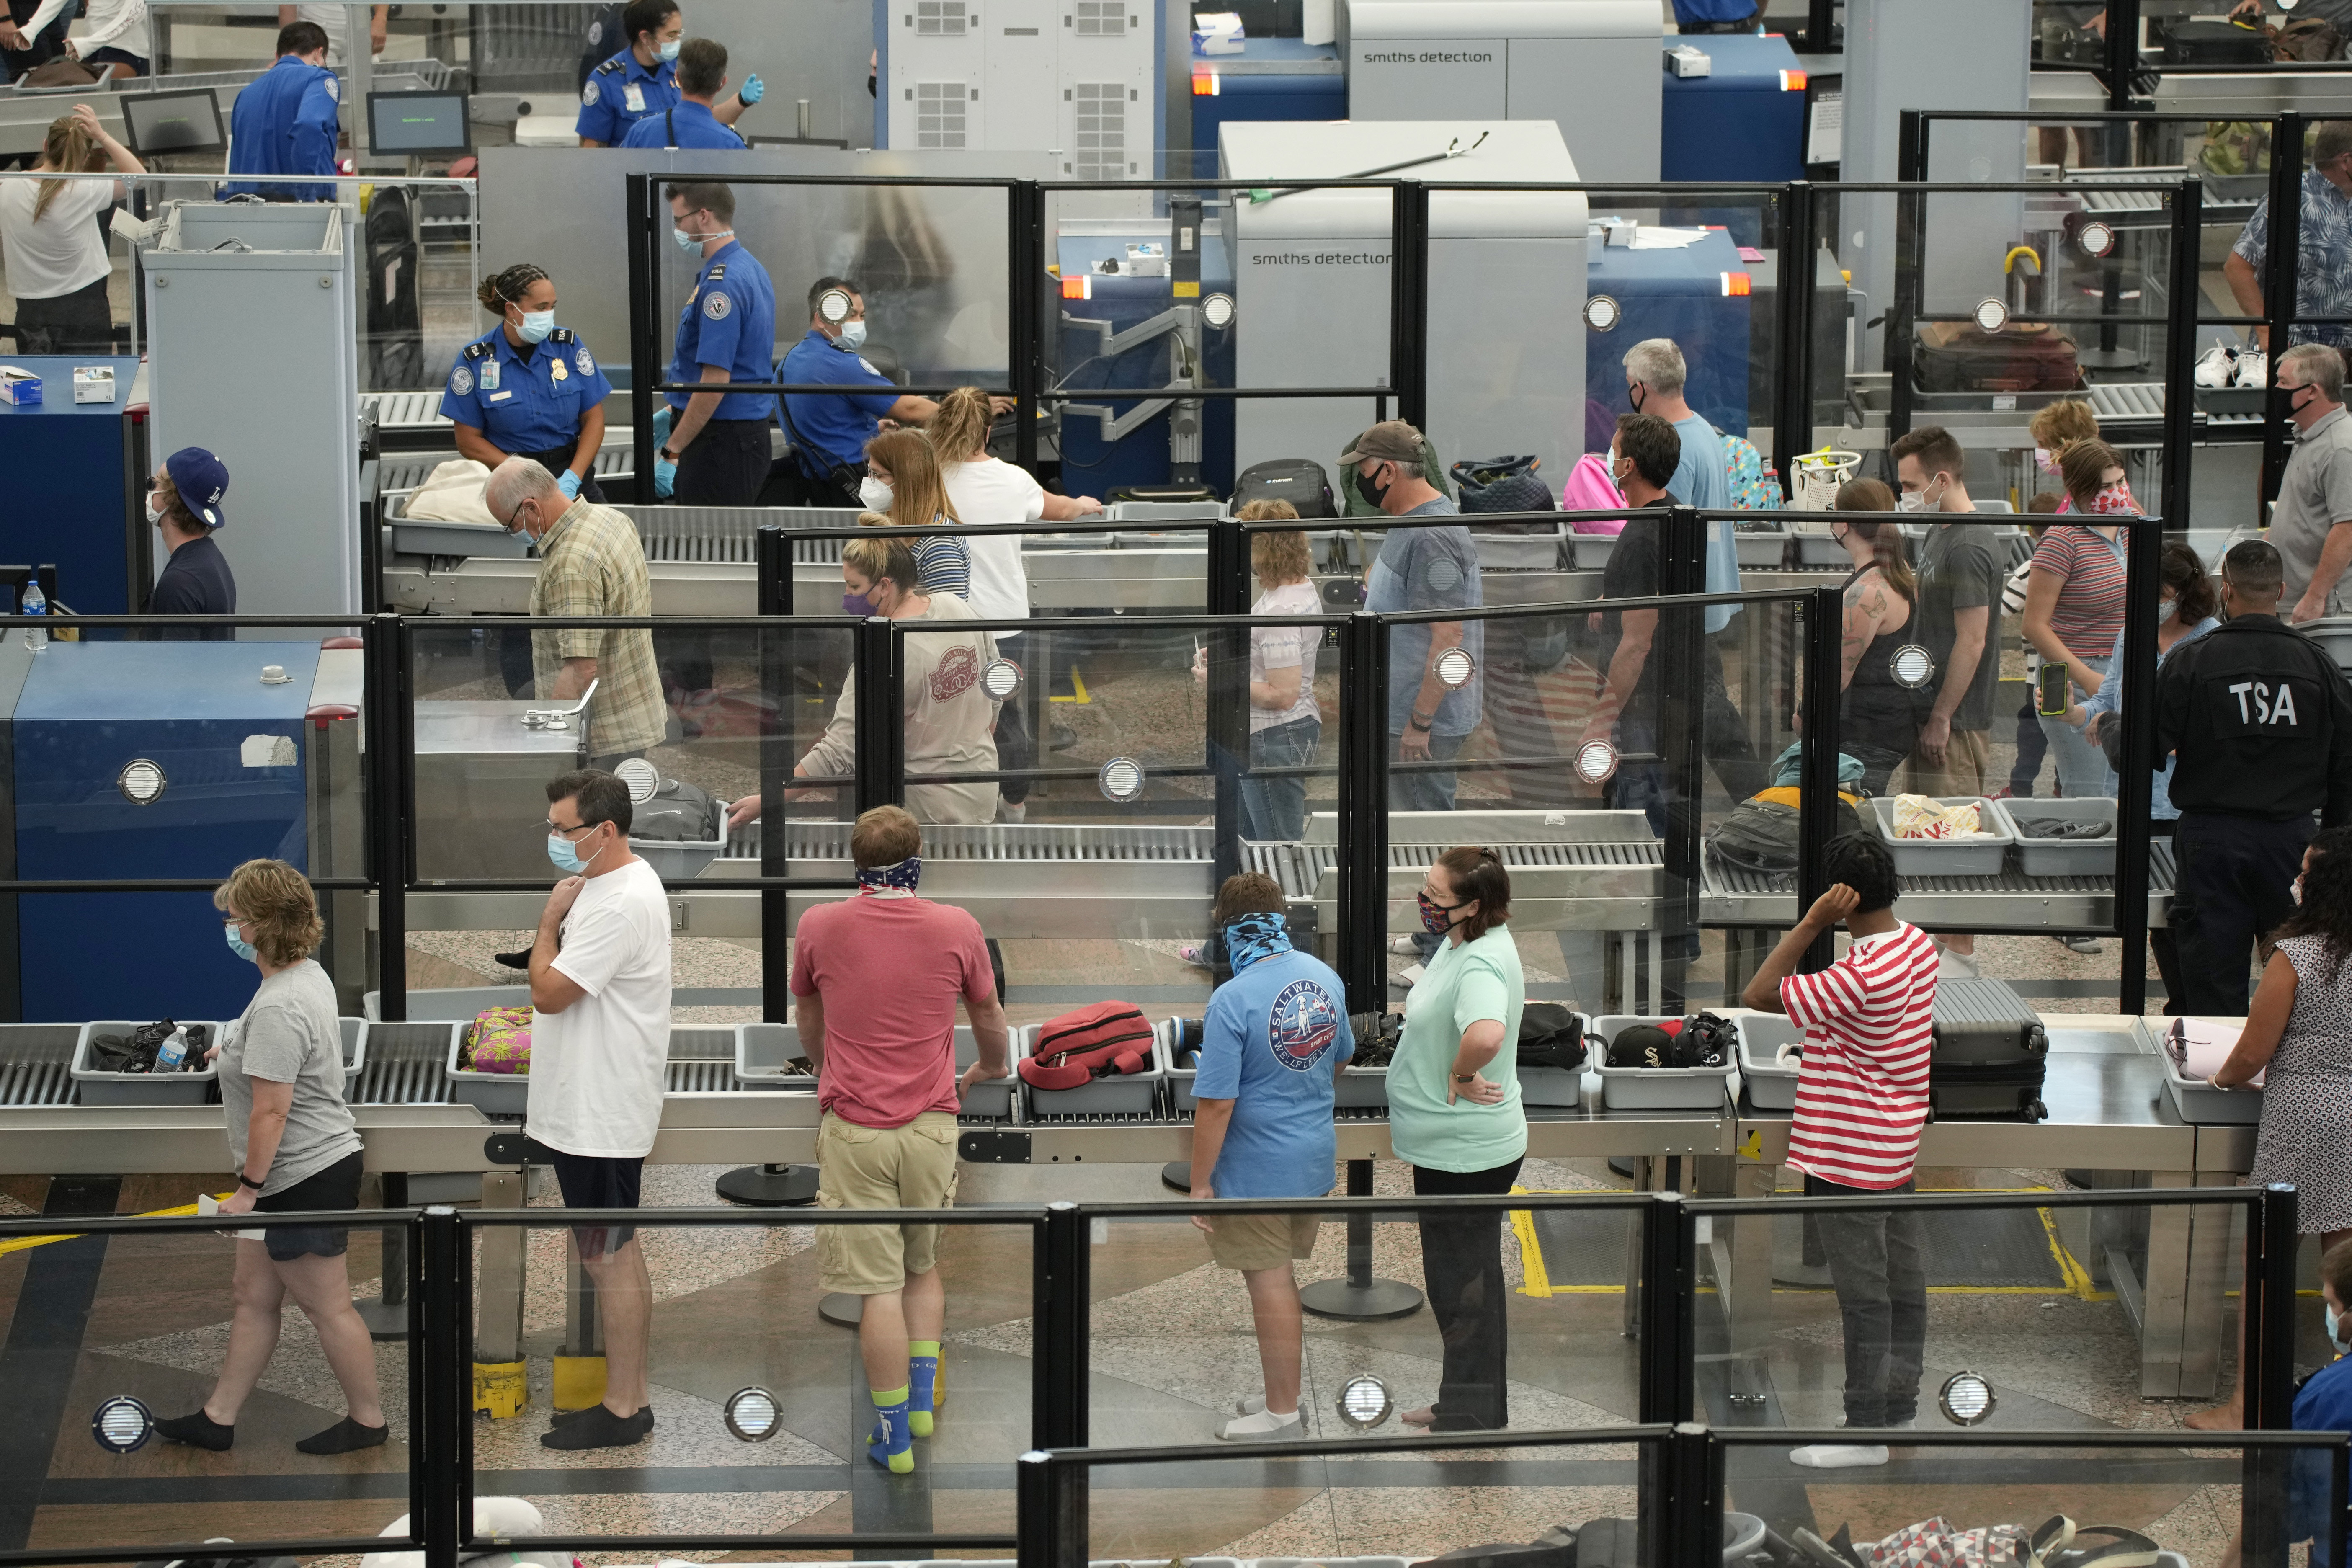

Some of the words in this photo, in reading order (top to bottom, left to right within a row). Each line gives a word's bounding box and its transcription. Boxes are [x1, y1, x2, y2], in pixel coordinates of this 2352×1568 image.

[1364, 52, 1416, 62] smiths
[1419, 52, 1492, 62] detection
[1253, 253, 1310, 265] smiths
[470, 344, 480, 357] TSA
[207, 487, 220, 504] LA
[944, 668, 958, 679] NIGHT
[959, 656, 976, 670] SWEATS
[2229, 681, 2298, 725] TSA
[1910, 811, 1926, 823] QUALITY
[1272, 982, 1333, 1026] SALTWATER
[1310, 1037, 1323, 1048] SPIRIT
[1274, 1040, 1324, 1069] WELLFLEET
